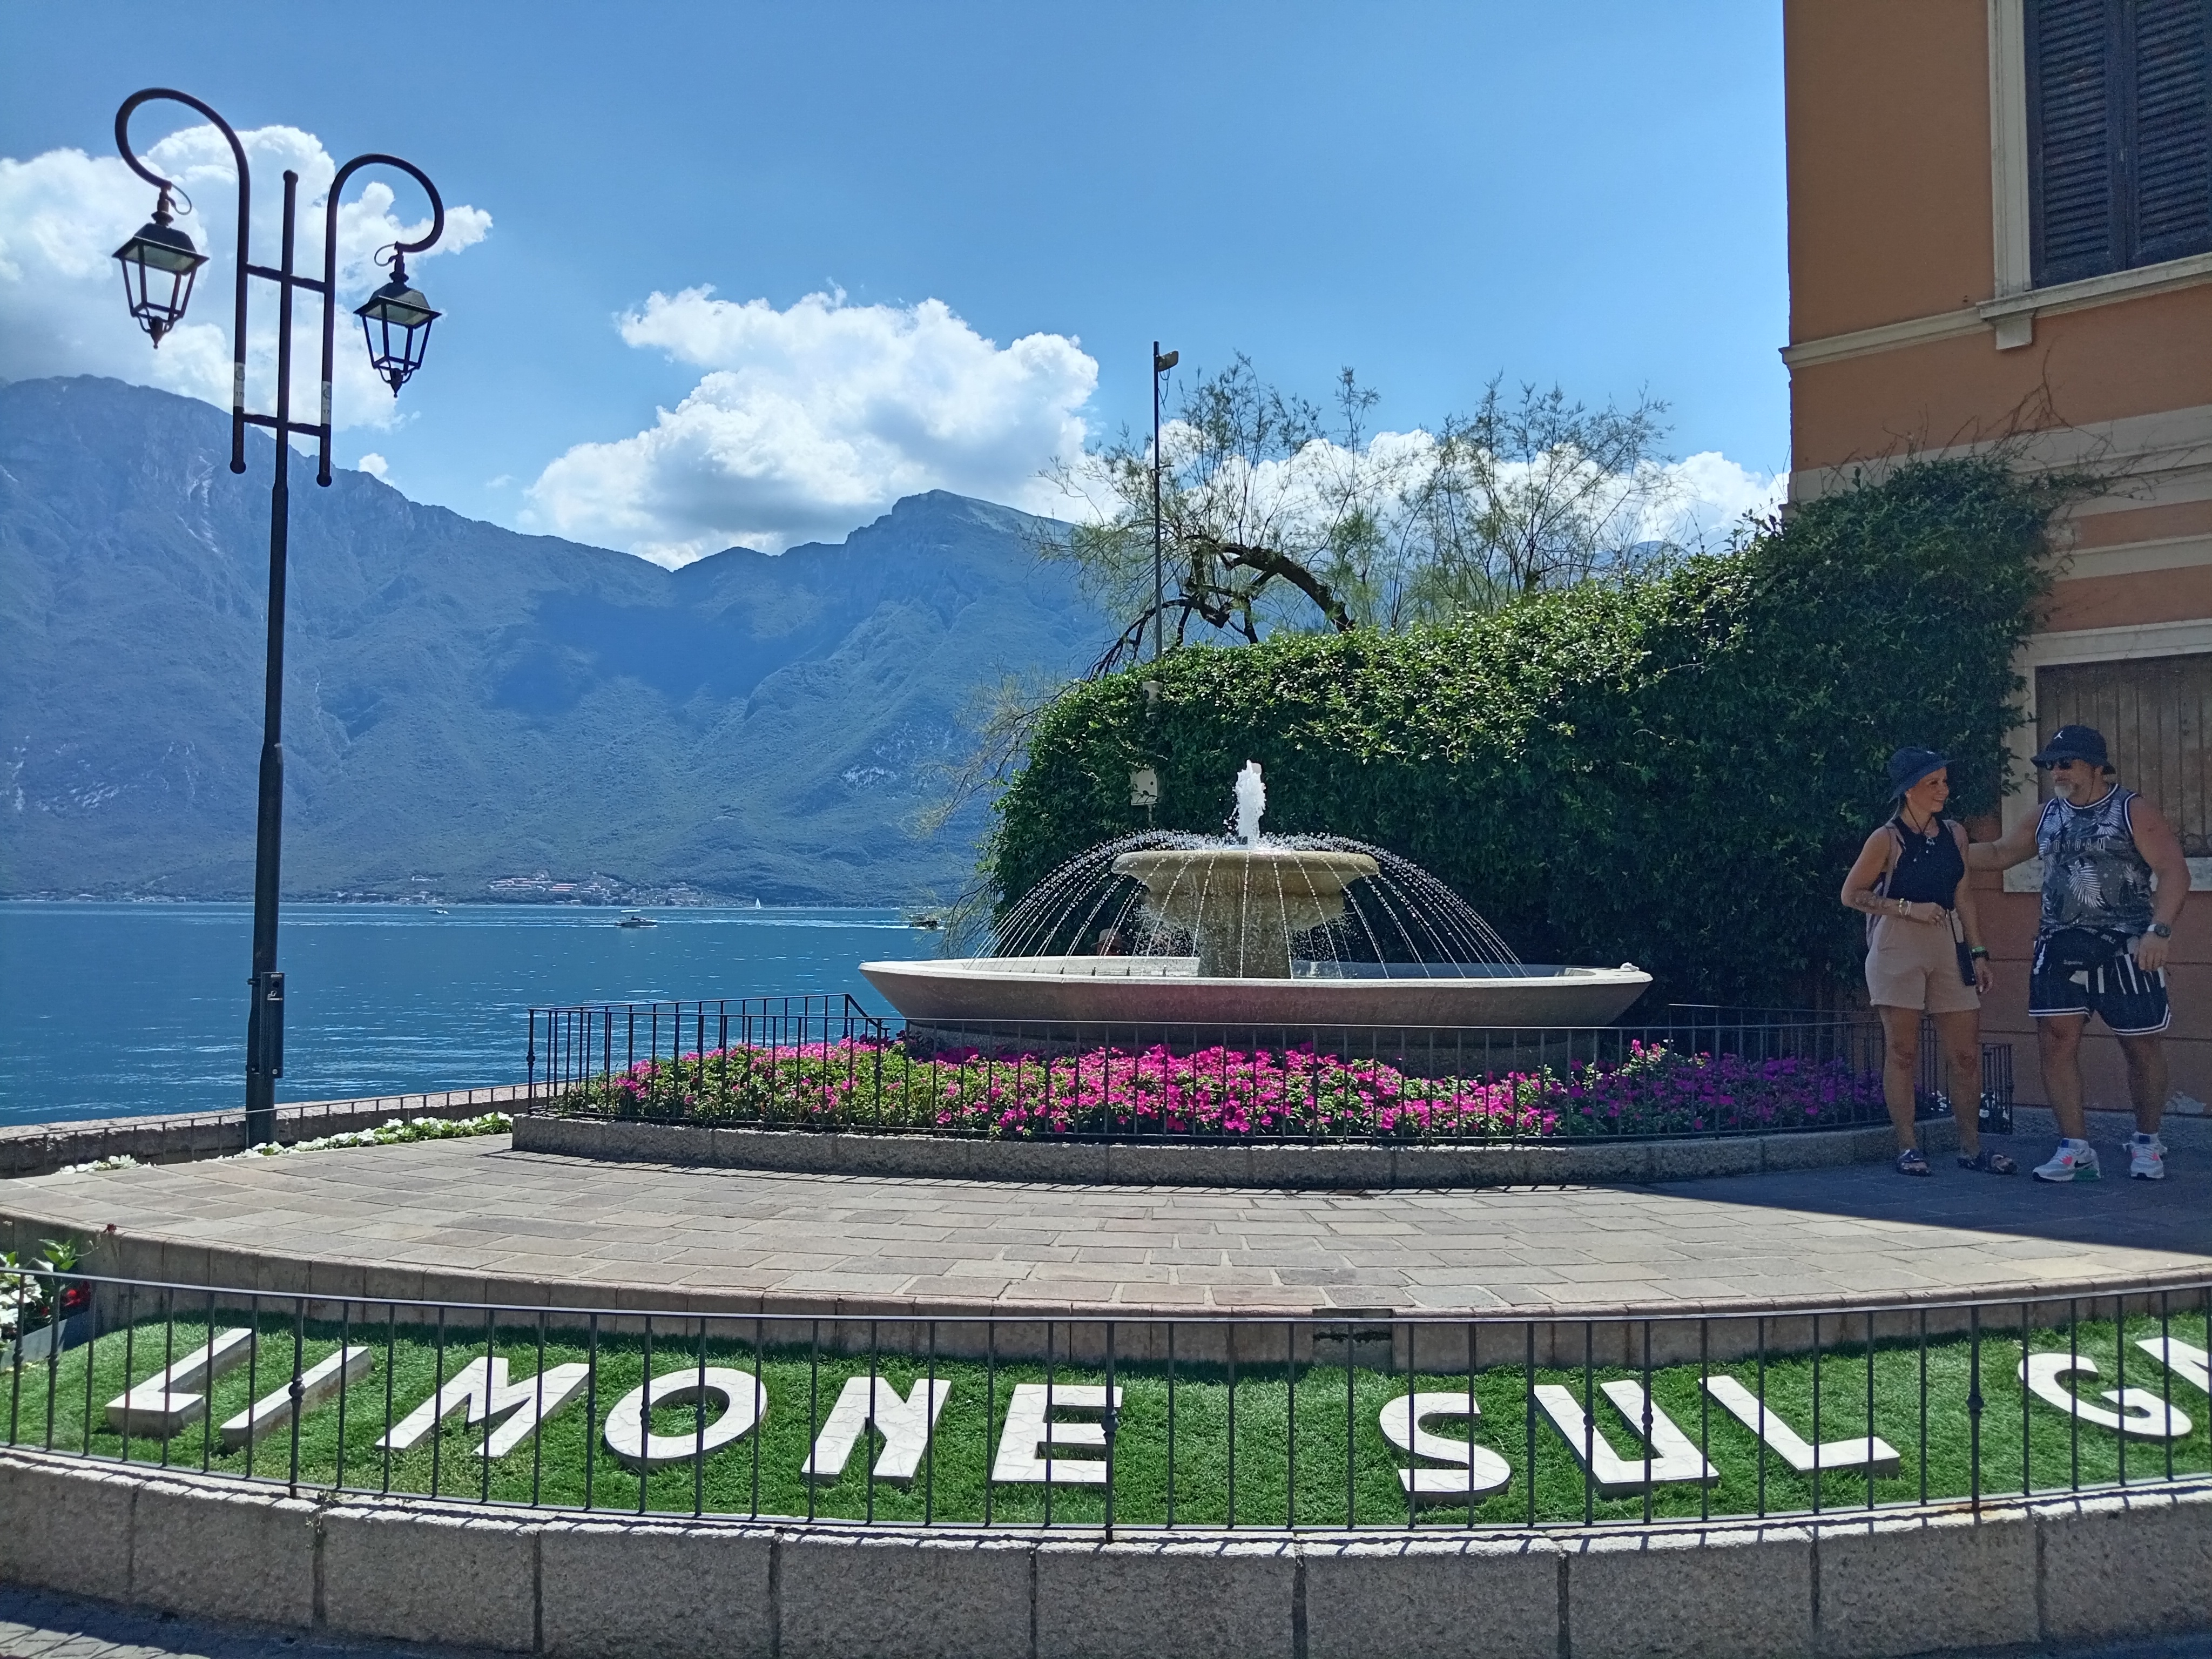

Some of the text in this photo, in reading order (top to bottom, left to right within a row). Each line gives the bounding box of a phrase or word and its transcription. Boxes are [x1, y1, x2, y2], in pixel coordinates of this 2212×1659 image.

[2044, 838, 2105, 852] JORDAN
[105, 1326, 1123, 1483] LIMONE
[1379, 1375, 1900, 1495] SUL
